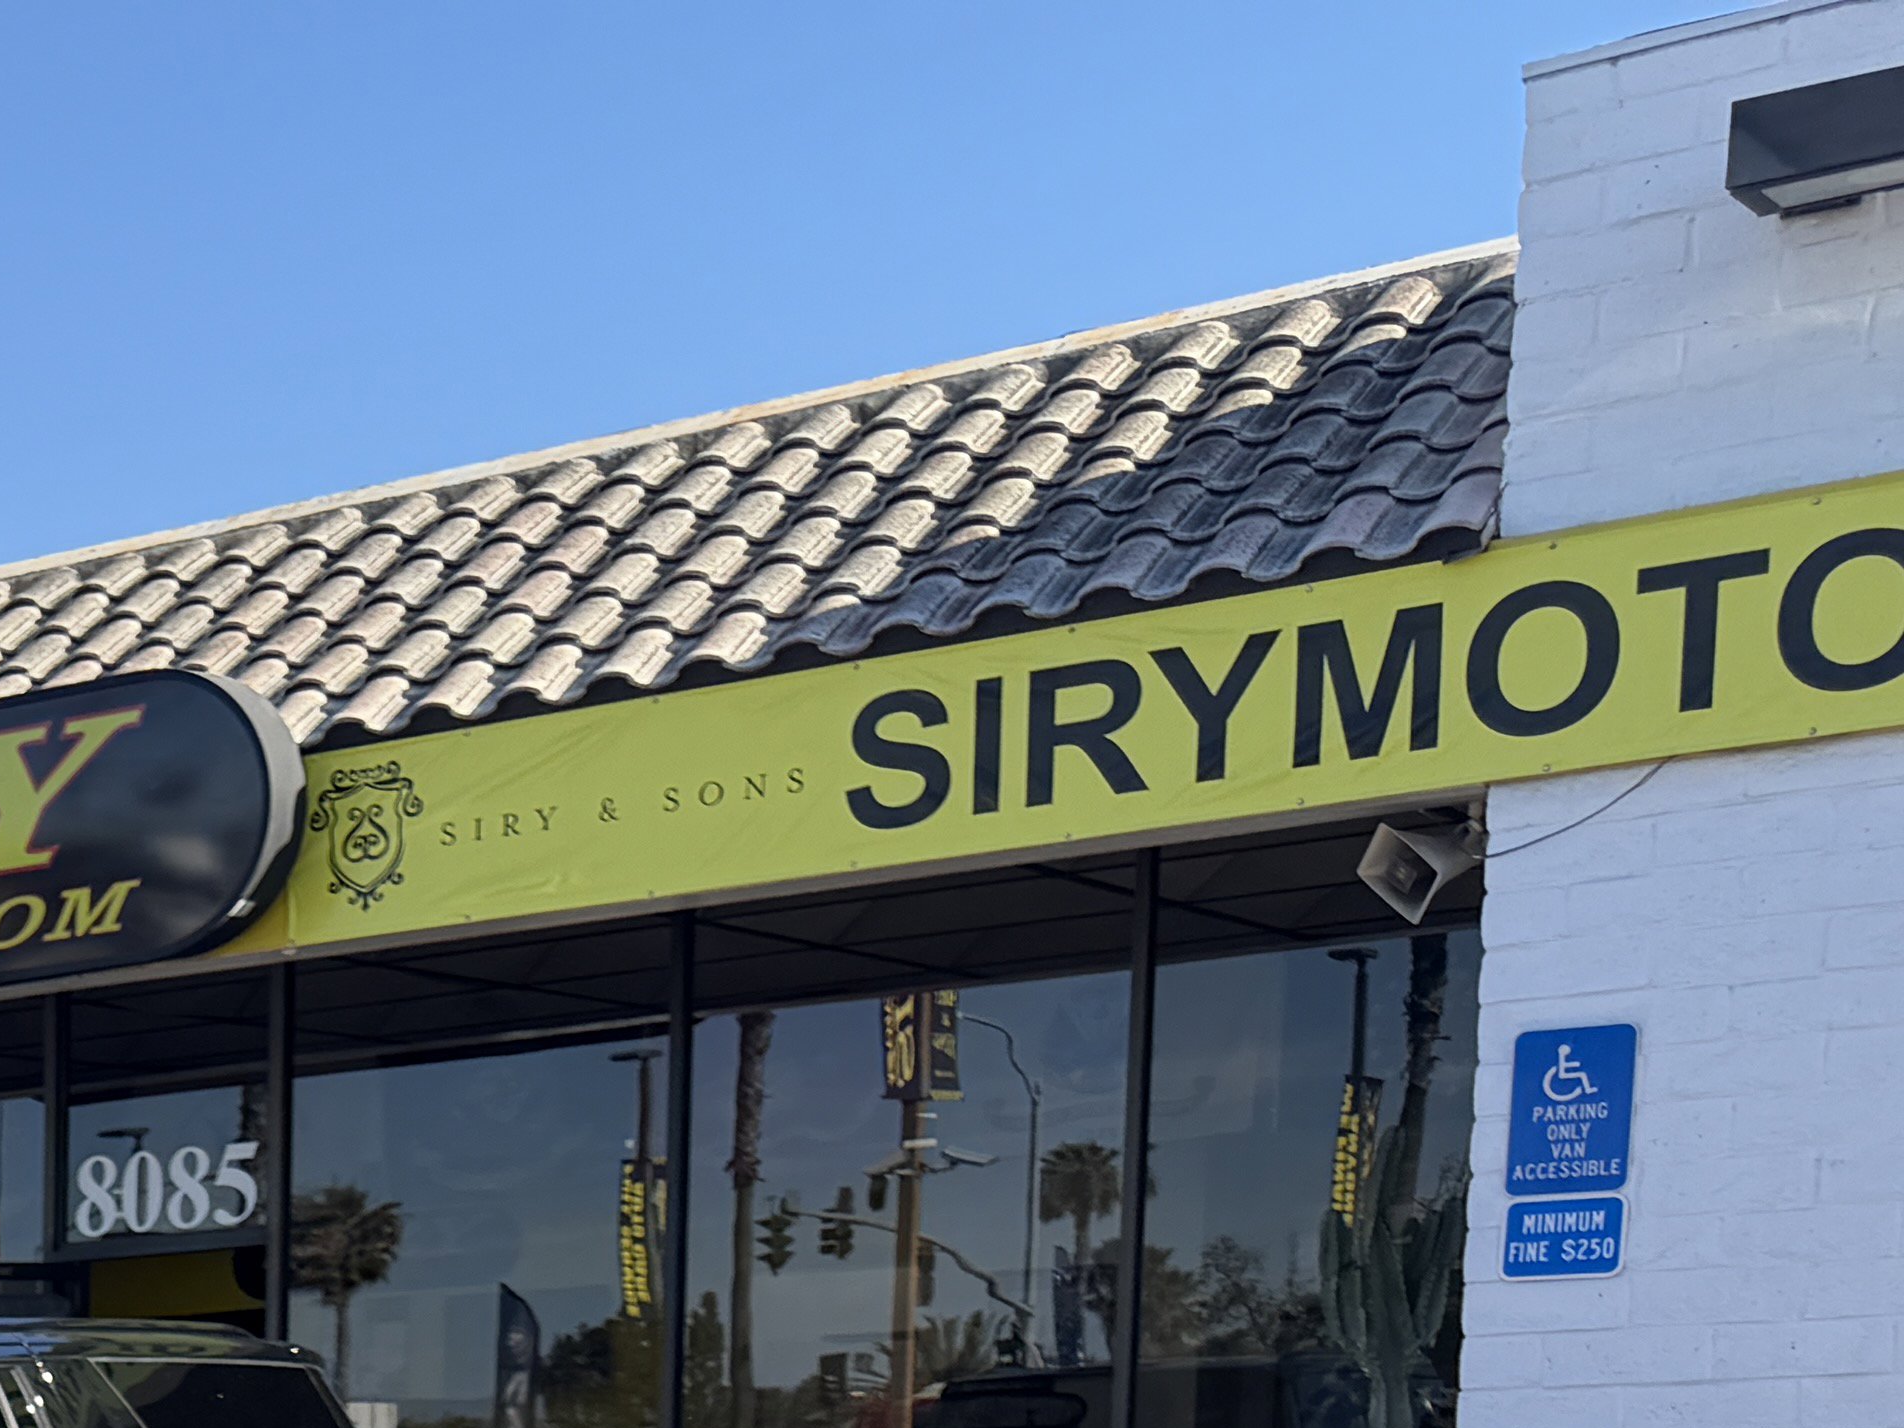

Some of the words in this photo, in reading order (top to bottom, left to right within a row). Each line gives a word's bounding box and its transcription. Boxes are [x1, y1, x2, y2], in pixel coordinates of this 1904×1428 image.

[439, 805, 559, 848] SIRY
[597, 795, 623, 824] &
[663, 767, 806, 814] SONS
[1532, 1101, 1609, 1123] PARKING
[1546, 1122, 1591, 1142] ONLY
[1550, 1141, 1586, 1160] VAN
[1512, 1157, 1621, 1182] ACCESSIBLE
[76, 1140, 260, 1239] 8085
[1522, 1209, 1606, 1236] MINIMUM
[1508, 1240, 1550, 1265] FINE
[1561, 1236, 1616, 1264] $250
